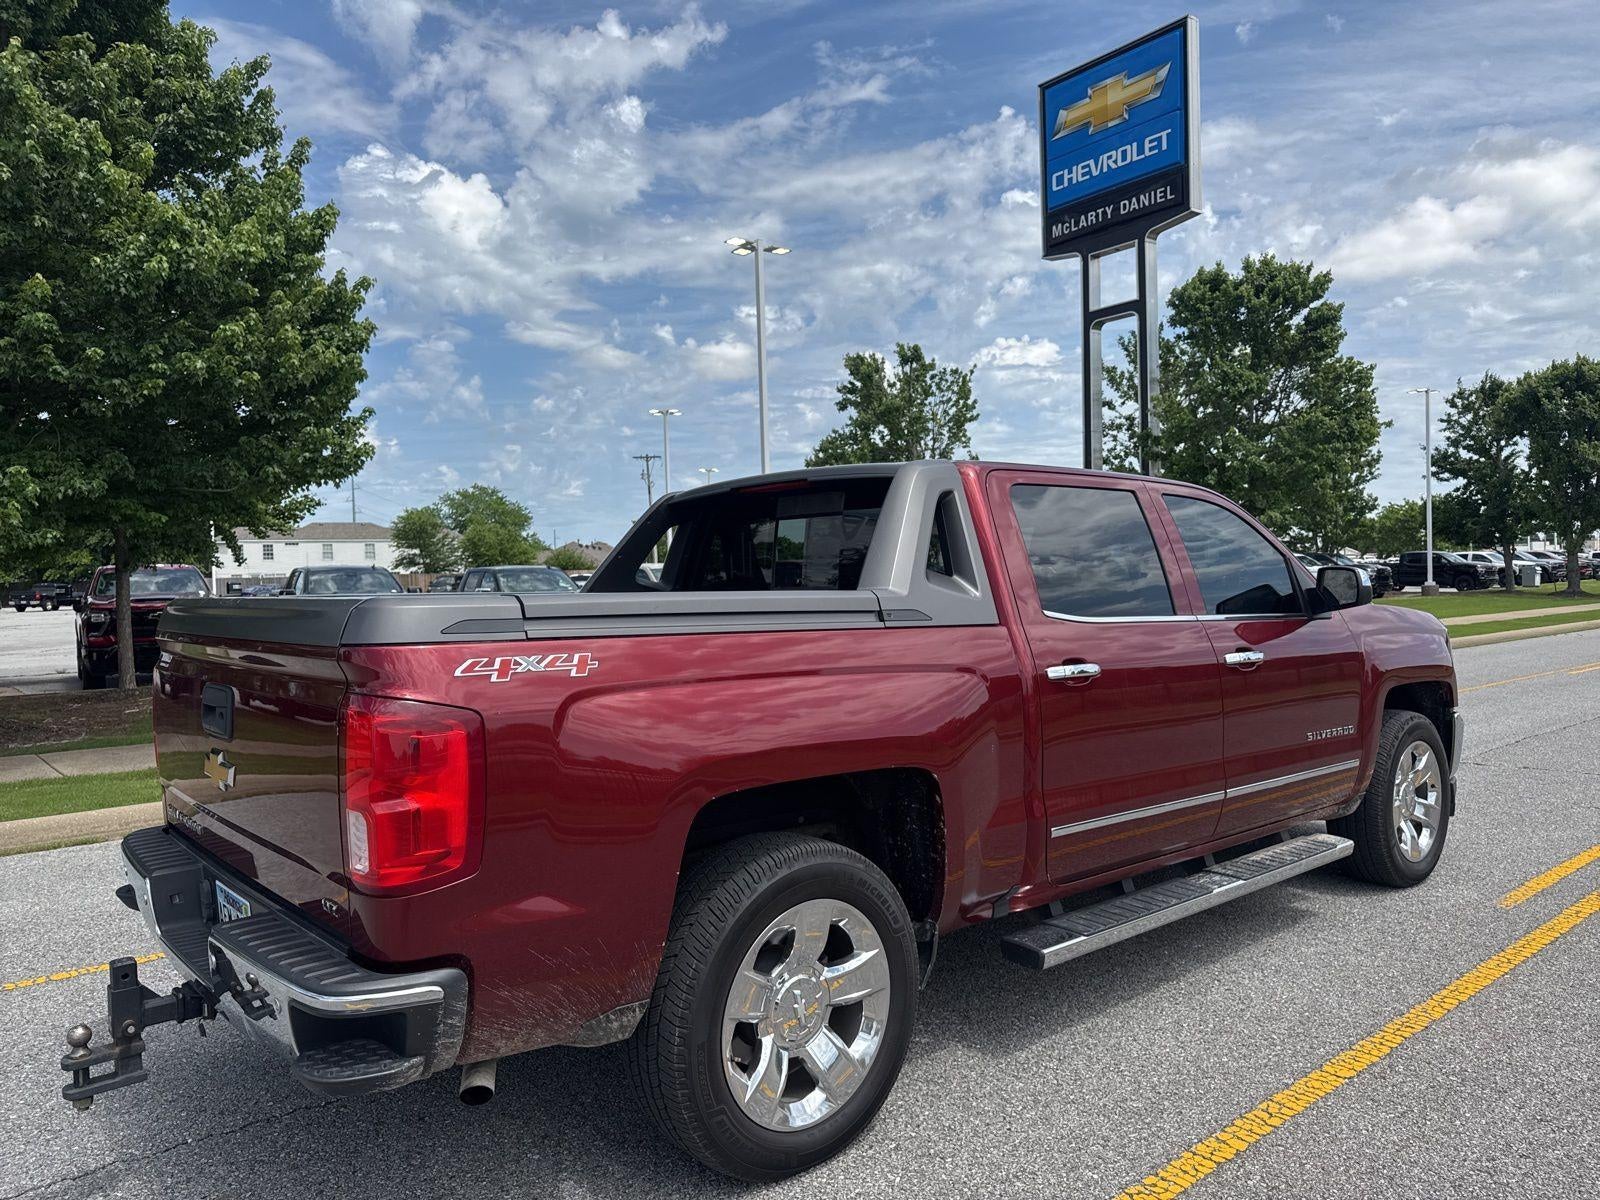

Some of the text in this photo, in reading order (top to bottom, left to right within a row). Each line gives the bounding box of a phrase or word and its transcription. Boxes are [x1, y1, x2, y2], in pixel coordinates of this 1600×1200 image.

[1052, 129, 1171, 192] CHEVROLET
[1052, 185, 1175, 238] McLARTY DANIEL
[1306, 725, 1355, 741] SILVERADO
